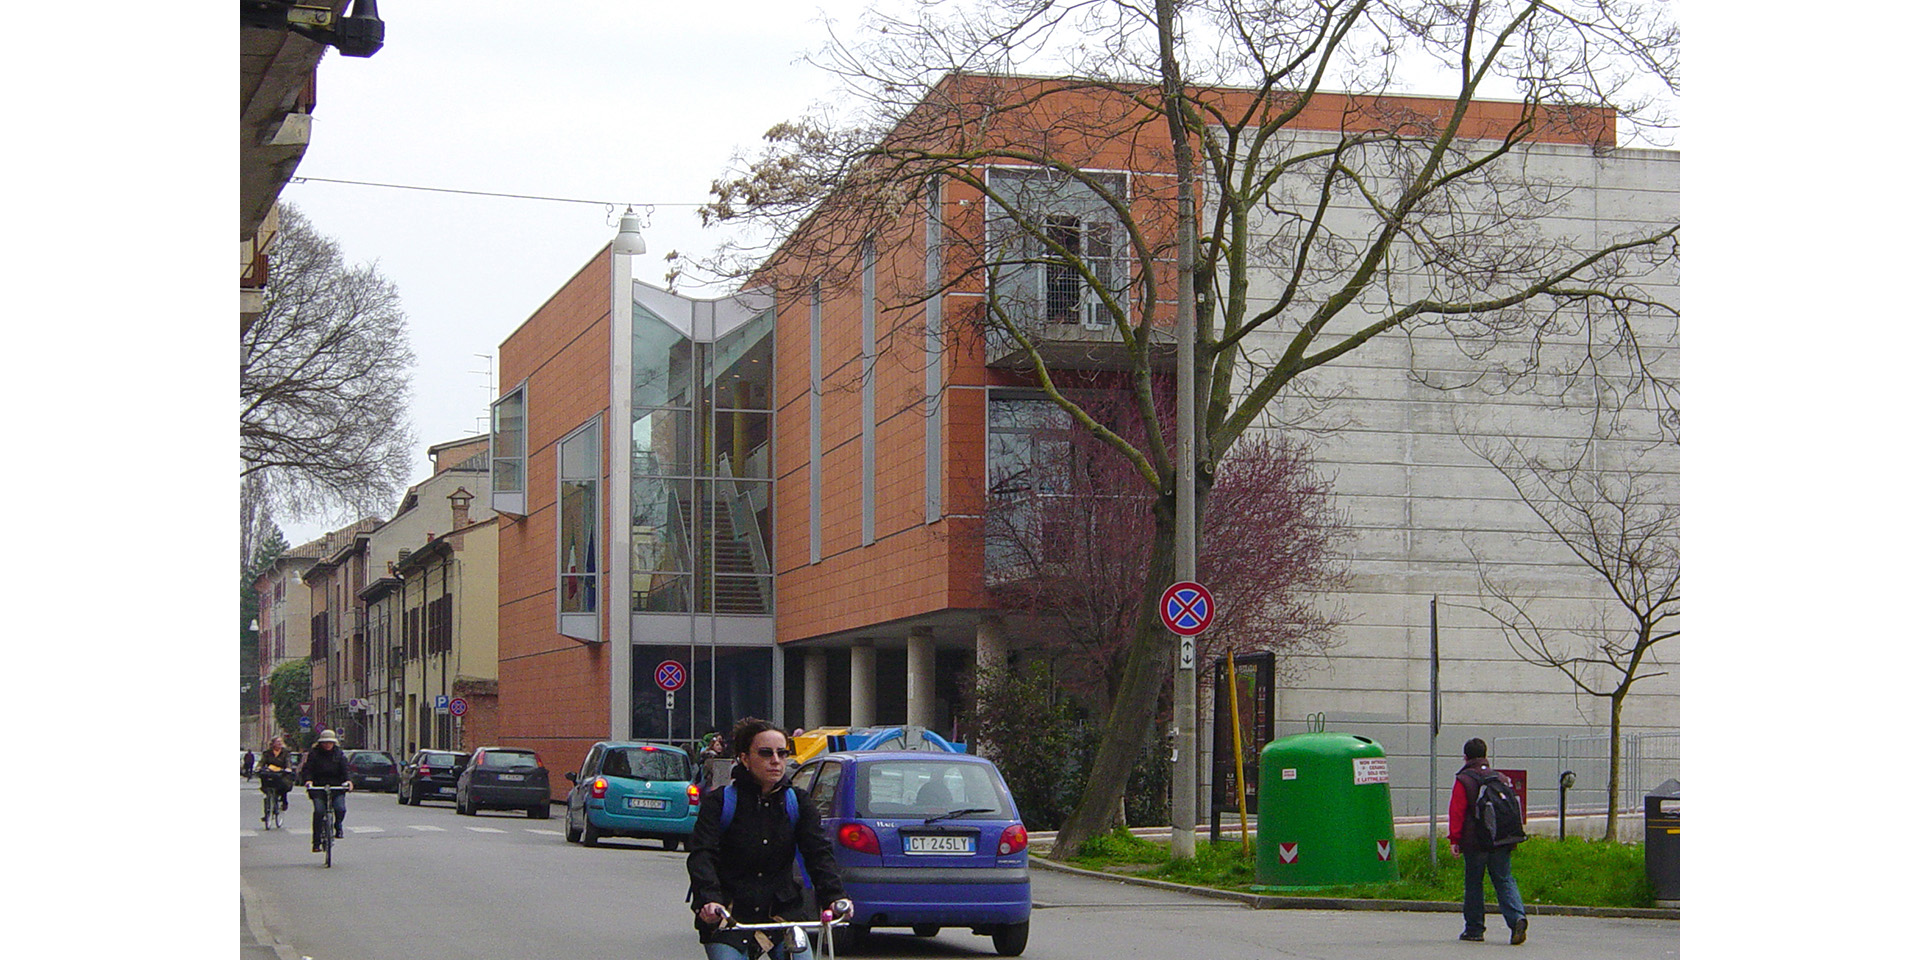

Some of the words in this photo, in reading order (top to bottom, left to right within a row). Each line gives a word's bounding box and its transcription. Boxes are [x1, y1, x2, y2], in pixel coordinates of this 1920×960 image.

[438, 697, 447, 707] P
[911, 838, 927, 850] CT
[931, 838, 967, 850] 245LY
